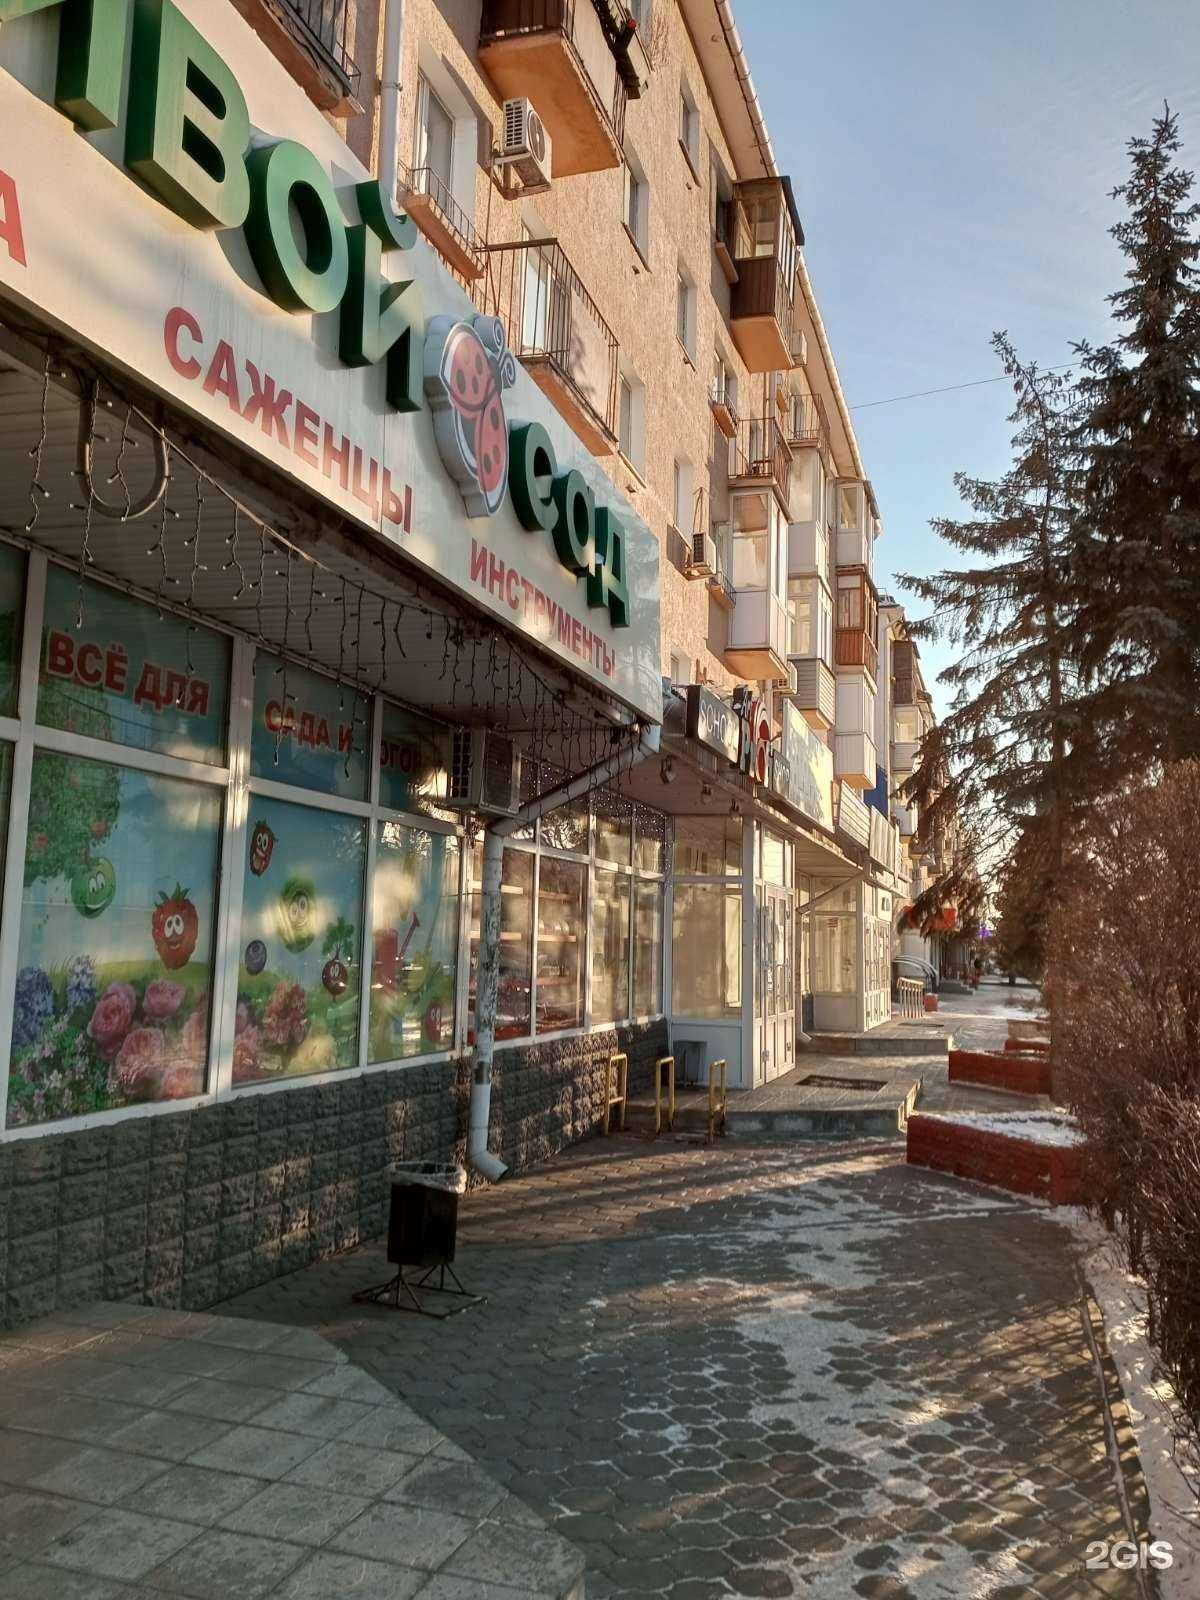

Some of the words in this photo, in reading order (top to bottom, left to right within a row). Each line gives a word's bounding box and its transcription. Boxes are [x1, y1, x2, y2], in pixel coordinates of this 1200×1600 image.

[163, 306, 412, 534] САЖЕНЦЫ
[470, 537, 616, 679] ИНСТРУМЕНТЫ
[47, 630, 128, 694] ВСЁ
[134, 661, 211, 717] ДЛЯ
[264, 700, 331, 747] САДА
[338, 724, 353, 753] И
